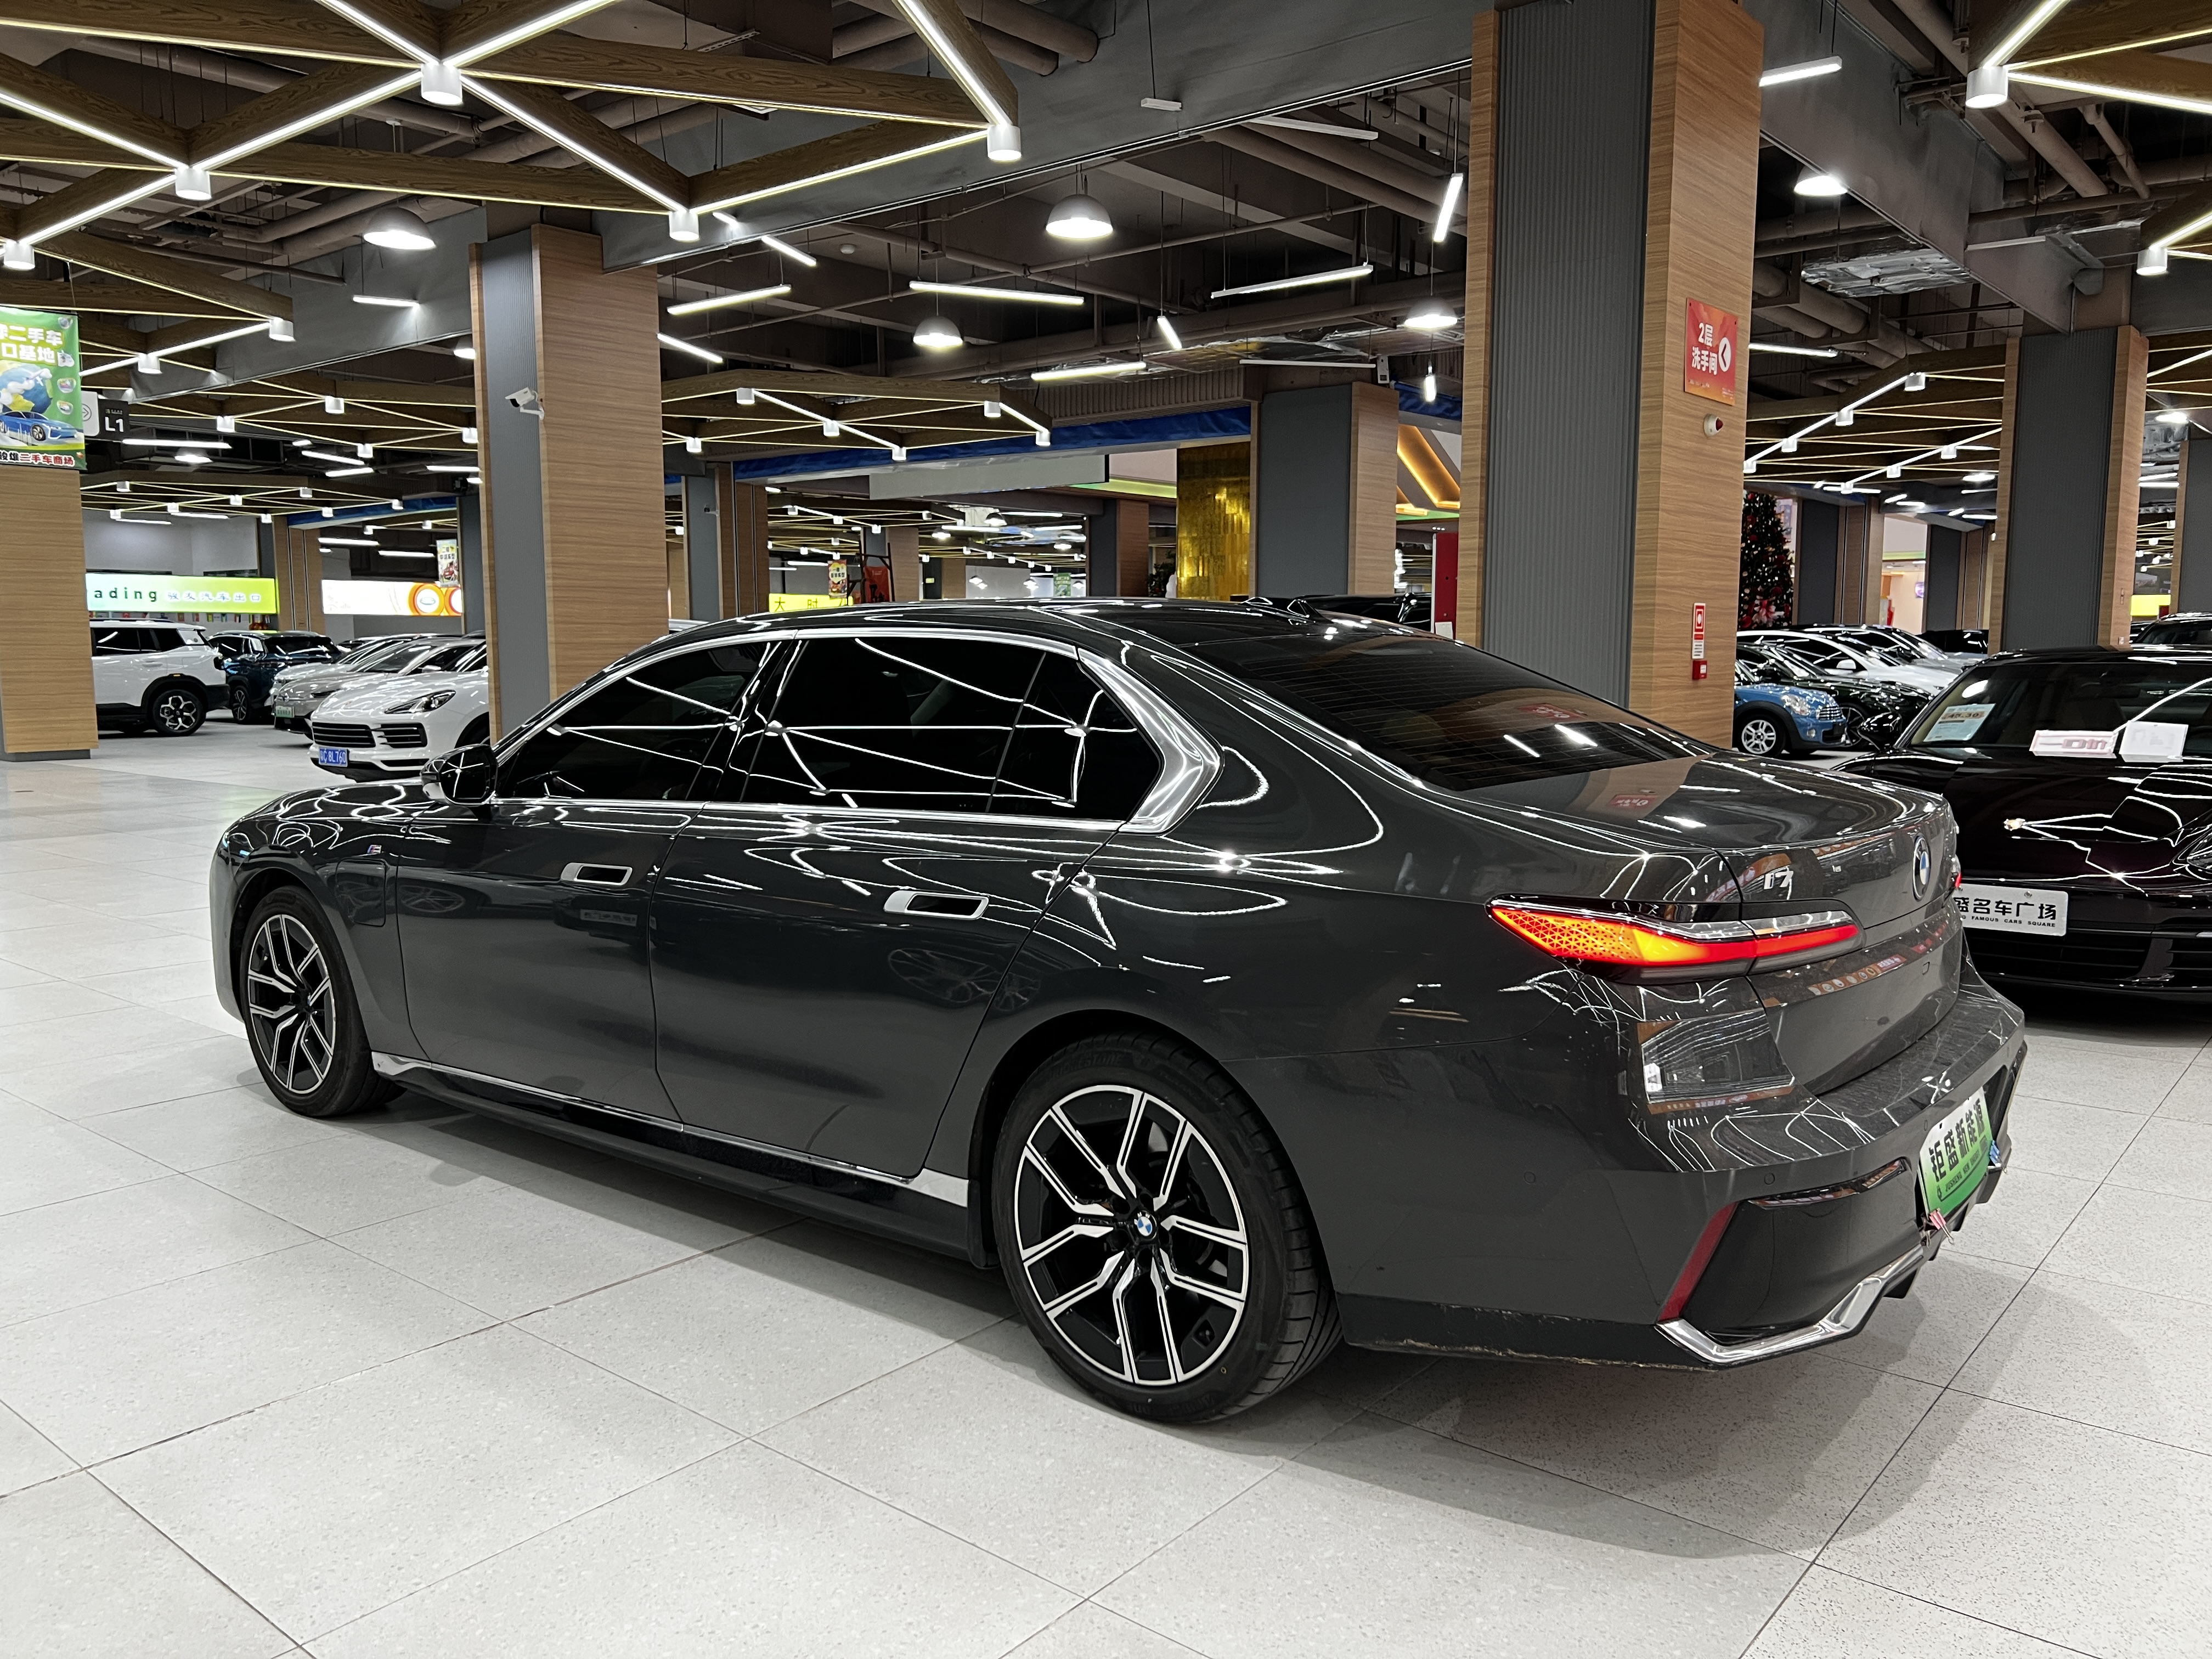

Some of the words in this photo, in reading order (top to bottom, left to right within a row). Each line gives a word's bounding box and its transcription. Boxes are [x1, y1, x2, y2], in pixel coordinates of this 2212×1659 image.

[1698, 322, 1713, 347] 2层
[1, 342, 55, 363] 口基地
[1692, 346, 1718, 375] 洗手间
[105, 416, 124, 432] L1
[1764, 870, 1794, 890] i7
